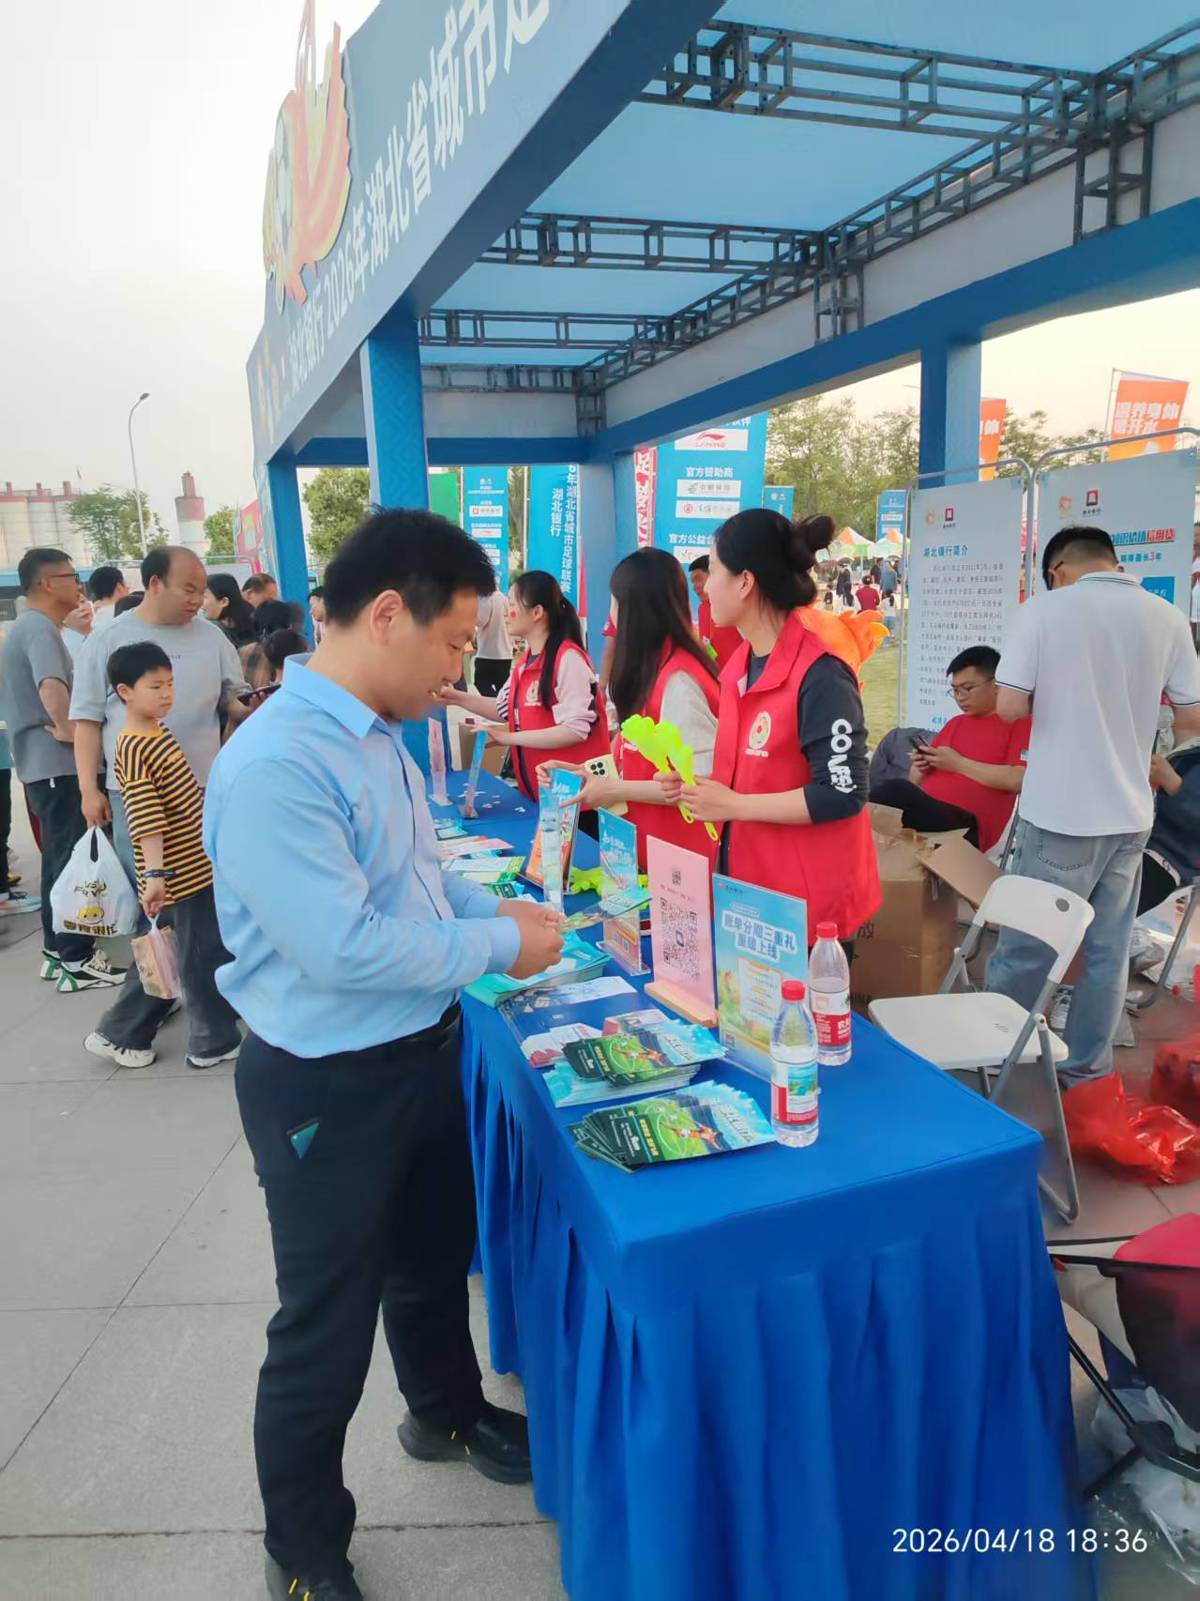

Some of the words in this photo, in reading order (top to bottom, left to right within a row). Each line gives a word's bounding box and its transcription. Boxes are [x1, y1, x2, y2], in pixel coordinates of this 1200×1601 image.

[686, 466, 734, 478] 官方赞助商
[923, 544, 968, 557] 湖北银行简介
